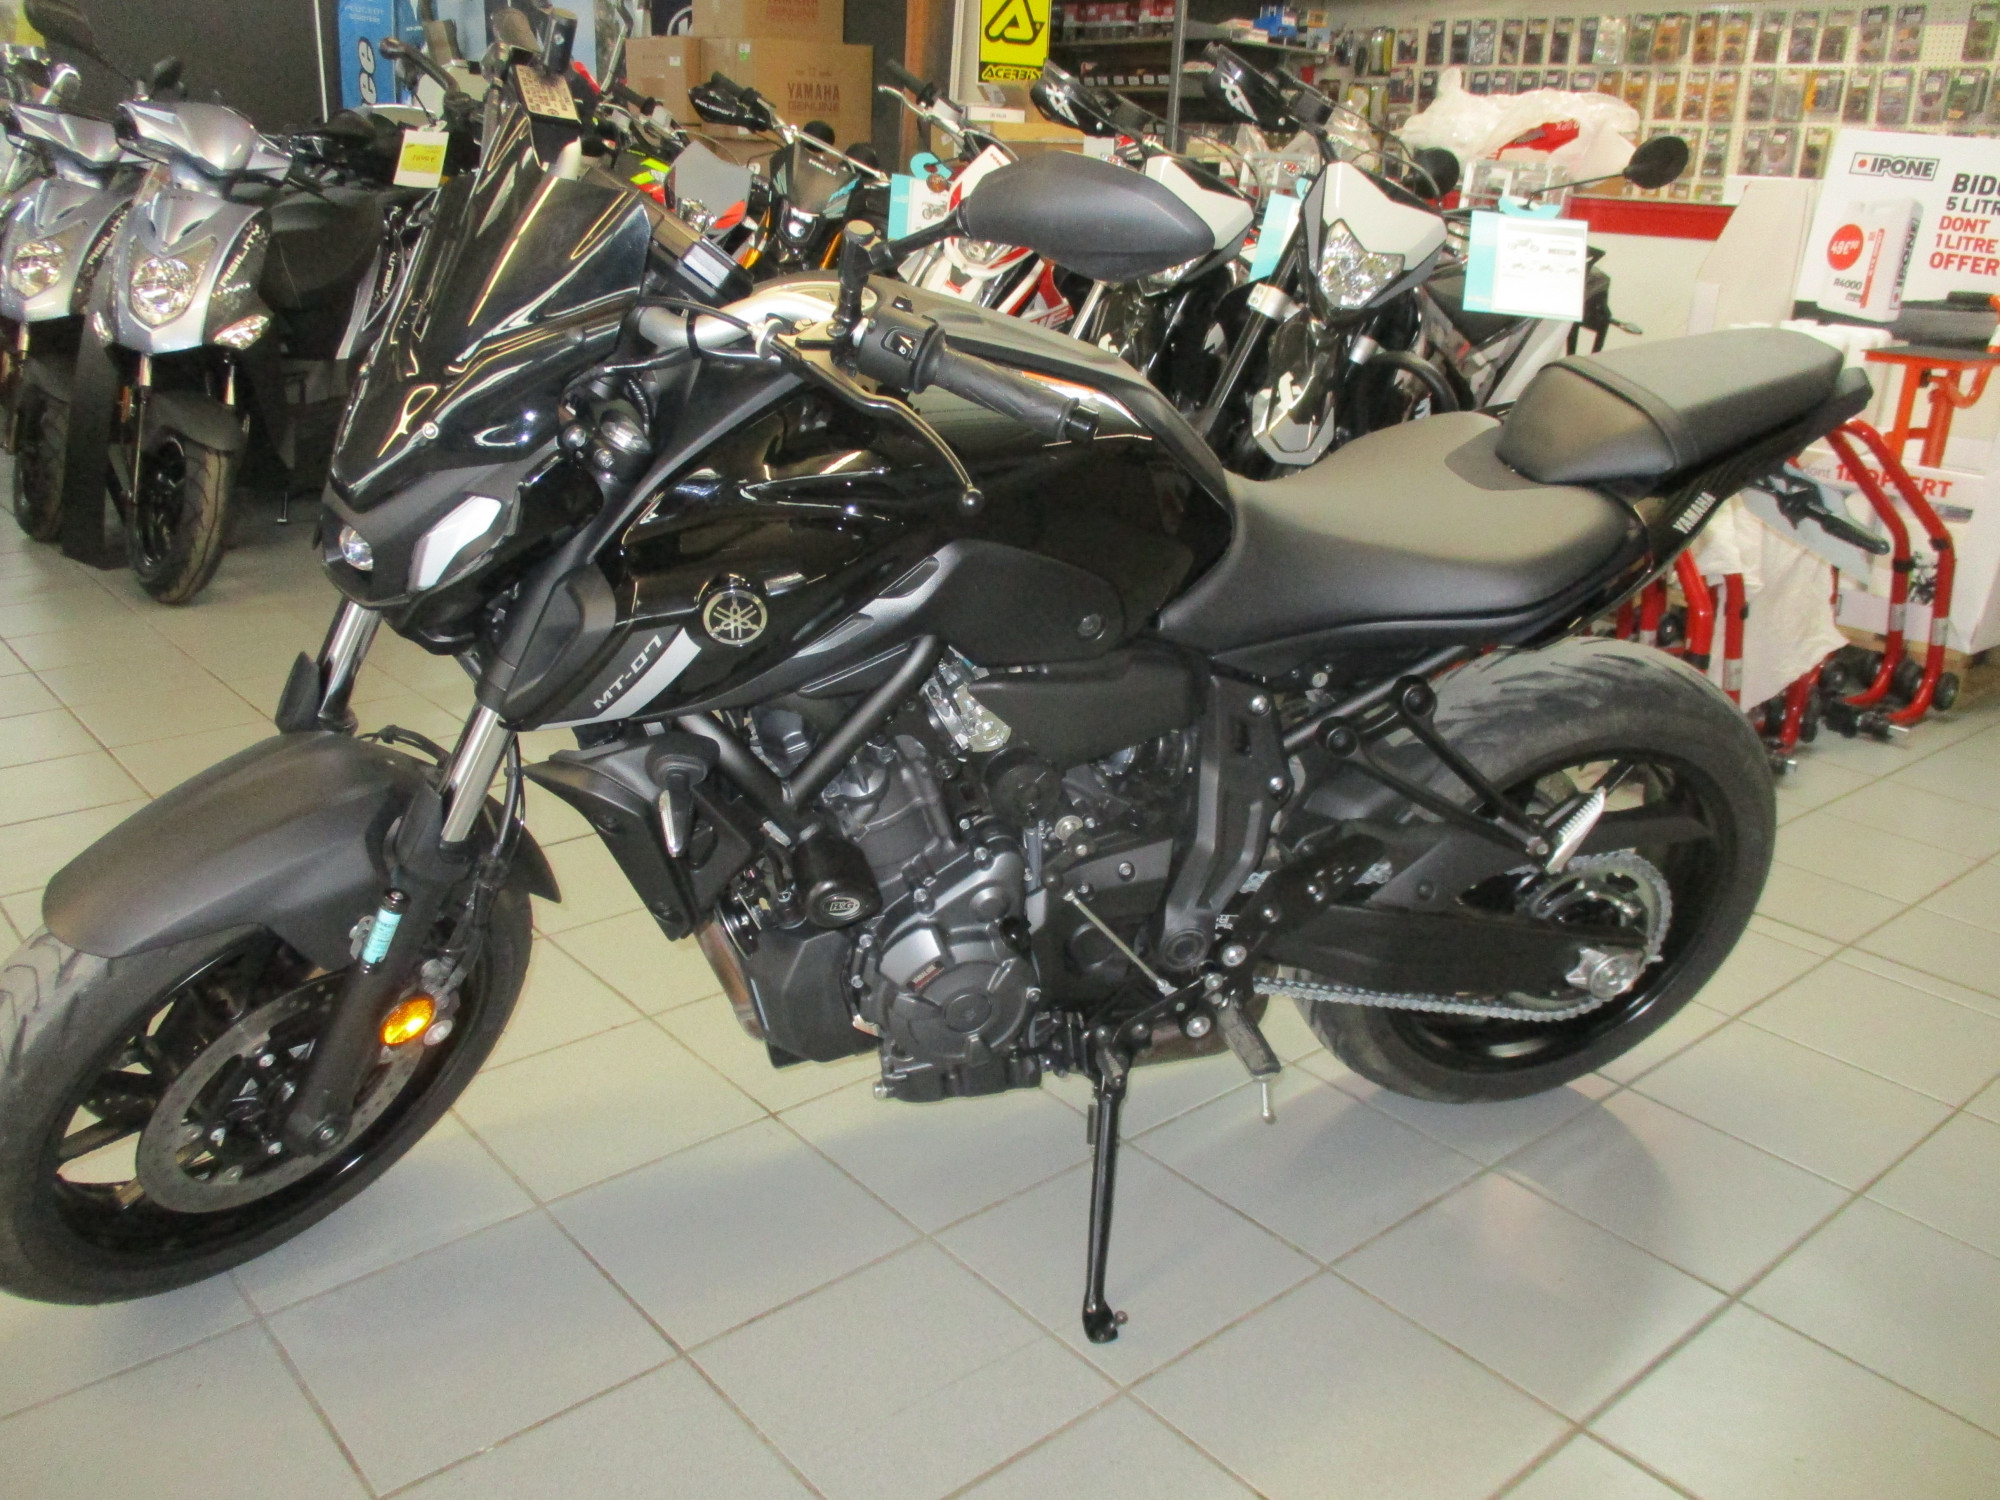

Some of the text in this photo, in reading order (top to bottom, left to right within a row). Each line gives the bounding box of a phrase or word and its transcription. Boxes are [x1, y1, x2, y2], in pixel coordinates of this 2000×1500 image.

[787, 82, 840, 101] YAMAHA
[787, 101, 840, 115] GENUINE
[1870, 157, 1935, 178] IPONE
[1951, 173, 2000, 197] BID
[1946, 196, 1958, 211] 5
[1939, 215, 1991, 235] DONT
[1936, 233, 1999, 254] 1 LITRE
[219, 222, 262, 287] AGILITY
[1672, 492, 1716, 534] YAMAHA
[593, 634, 662, 710] MT-07
